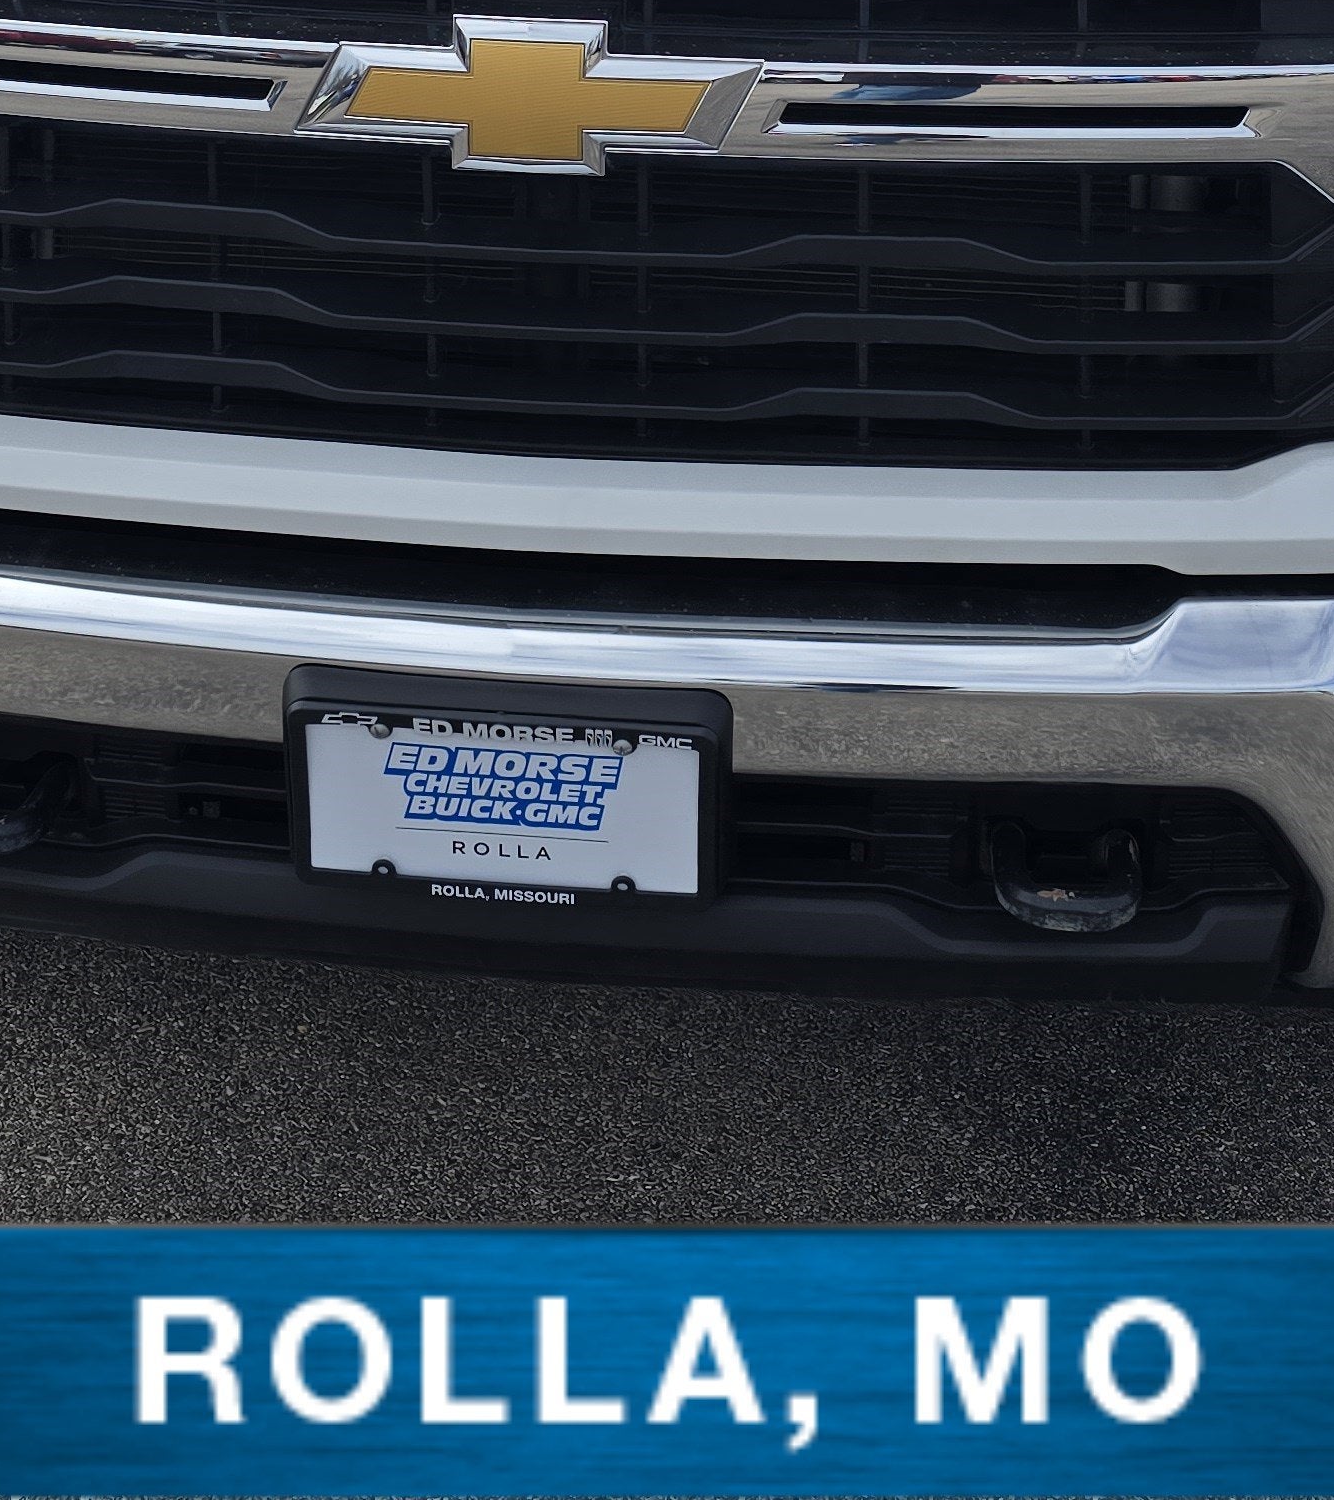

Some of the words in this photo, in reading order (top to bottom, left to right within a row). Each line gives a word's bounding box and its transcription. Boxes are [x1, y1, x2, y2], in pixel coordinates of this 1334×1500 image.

[412, 717, 453, 737] ED
[463, 722, 574, 743] MORSE
[638, 734, 693, 750] GMC
[387, 744, 449, 772] ED
[452, 749, 620, 783] MORSE
[406, 772, 603, 804] CHEVROLET
[452, 840, 551, 860] ROLLA
[431, 884, 489, 901] ROLLA,
[494, 888, 575, 905] MISSOURI
